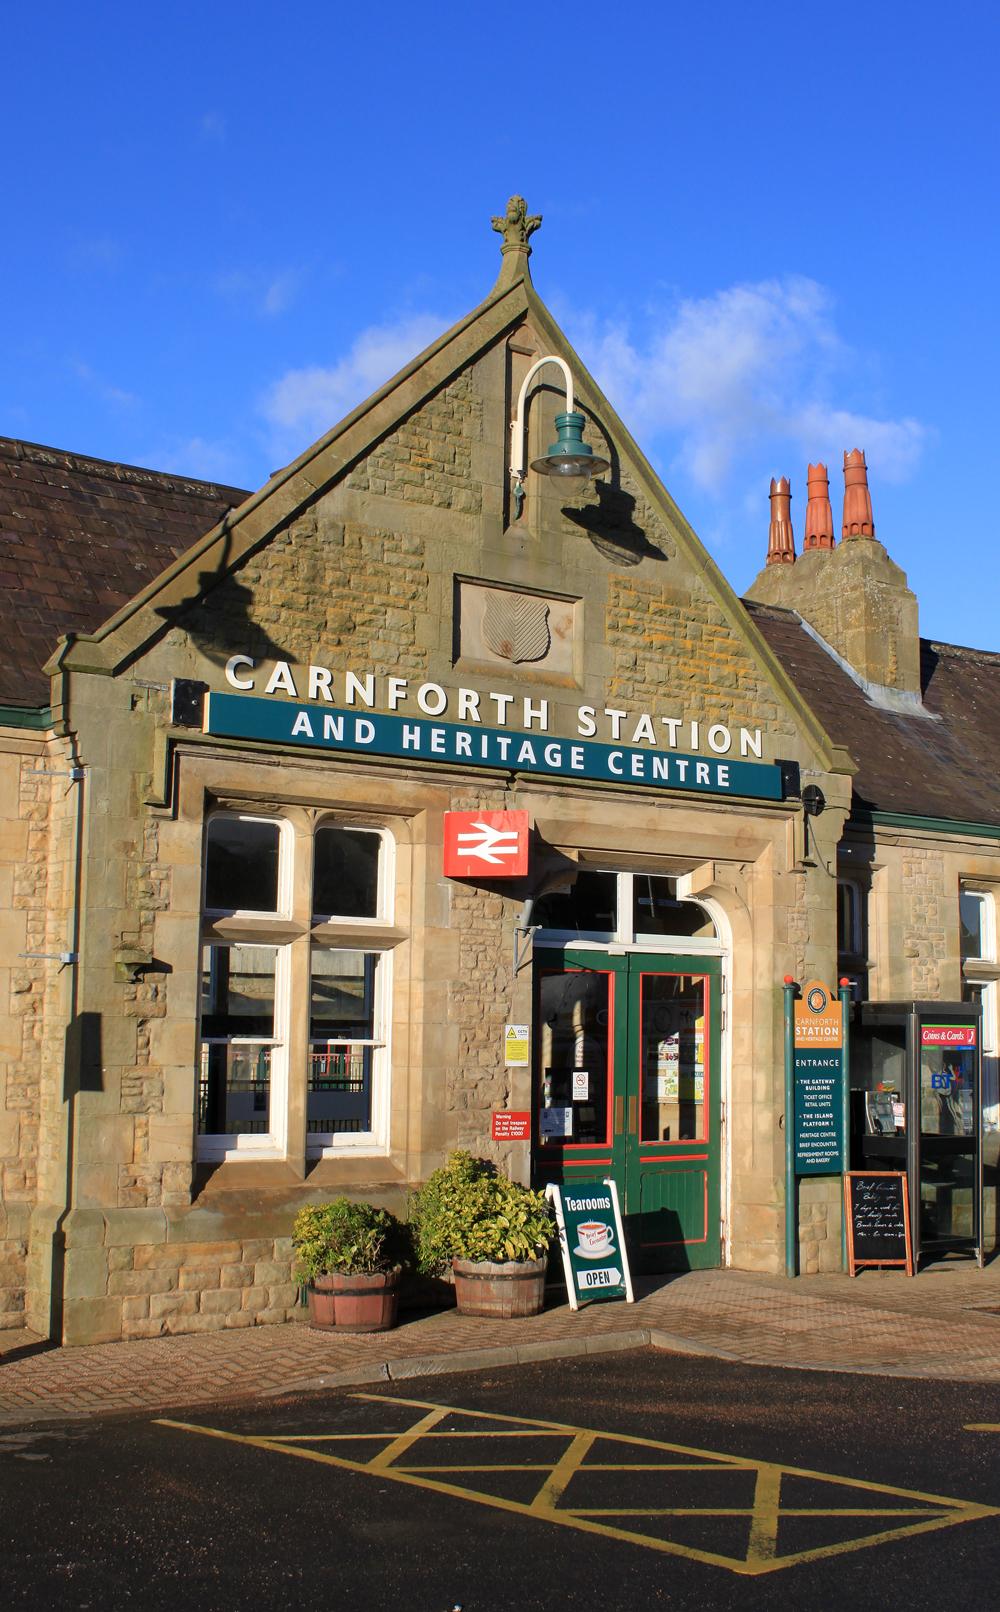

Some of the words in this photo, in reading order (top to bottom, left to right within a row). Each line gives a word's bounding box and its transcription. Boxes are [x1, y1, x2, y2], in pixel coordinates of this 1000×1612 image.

[225, 654, 548, 731] CARNFORTH
[577, 706, 762, 758] STATION
[291, 711, 376, 744] AND
[402, 724, 585, 770] HERITAGE
[607, 751, 730, 787] CENTRE
[795, 1017, 839, 1026] CARNFORTH
[795, 1027, 839, 1036] STATION
[923, 1030, 940, 1040] Coins
[940, 1032, 946, 1040] &
[946, 1030, 964, 1040] Cards
[932, 1074, 953, 1088] BT
[564, 1197, 610, 1212] Tearooms
[586, 1271, 610, 1286] OPEN
